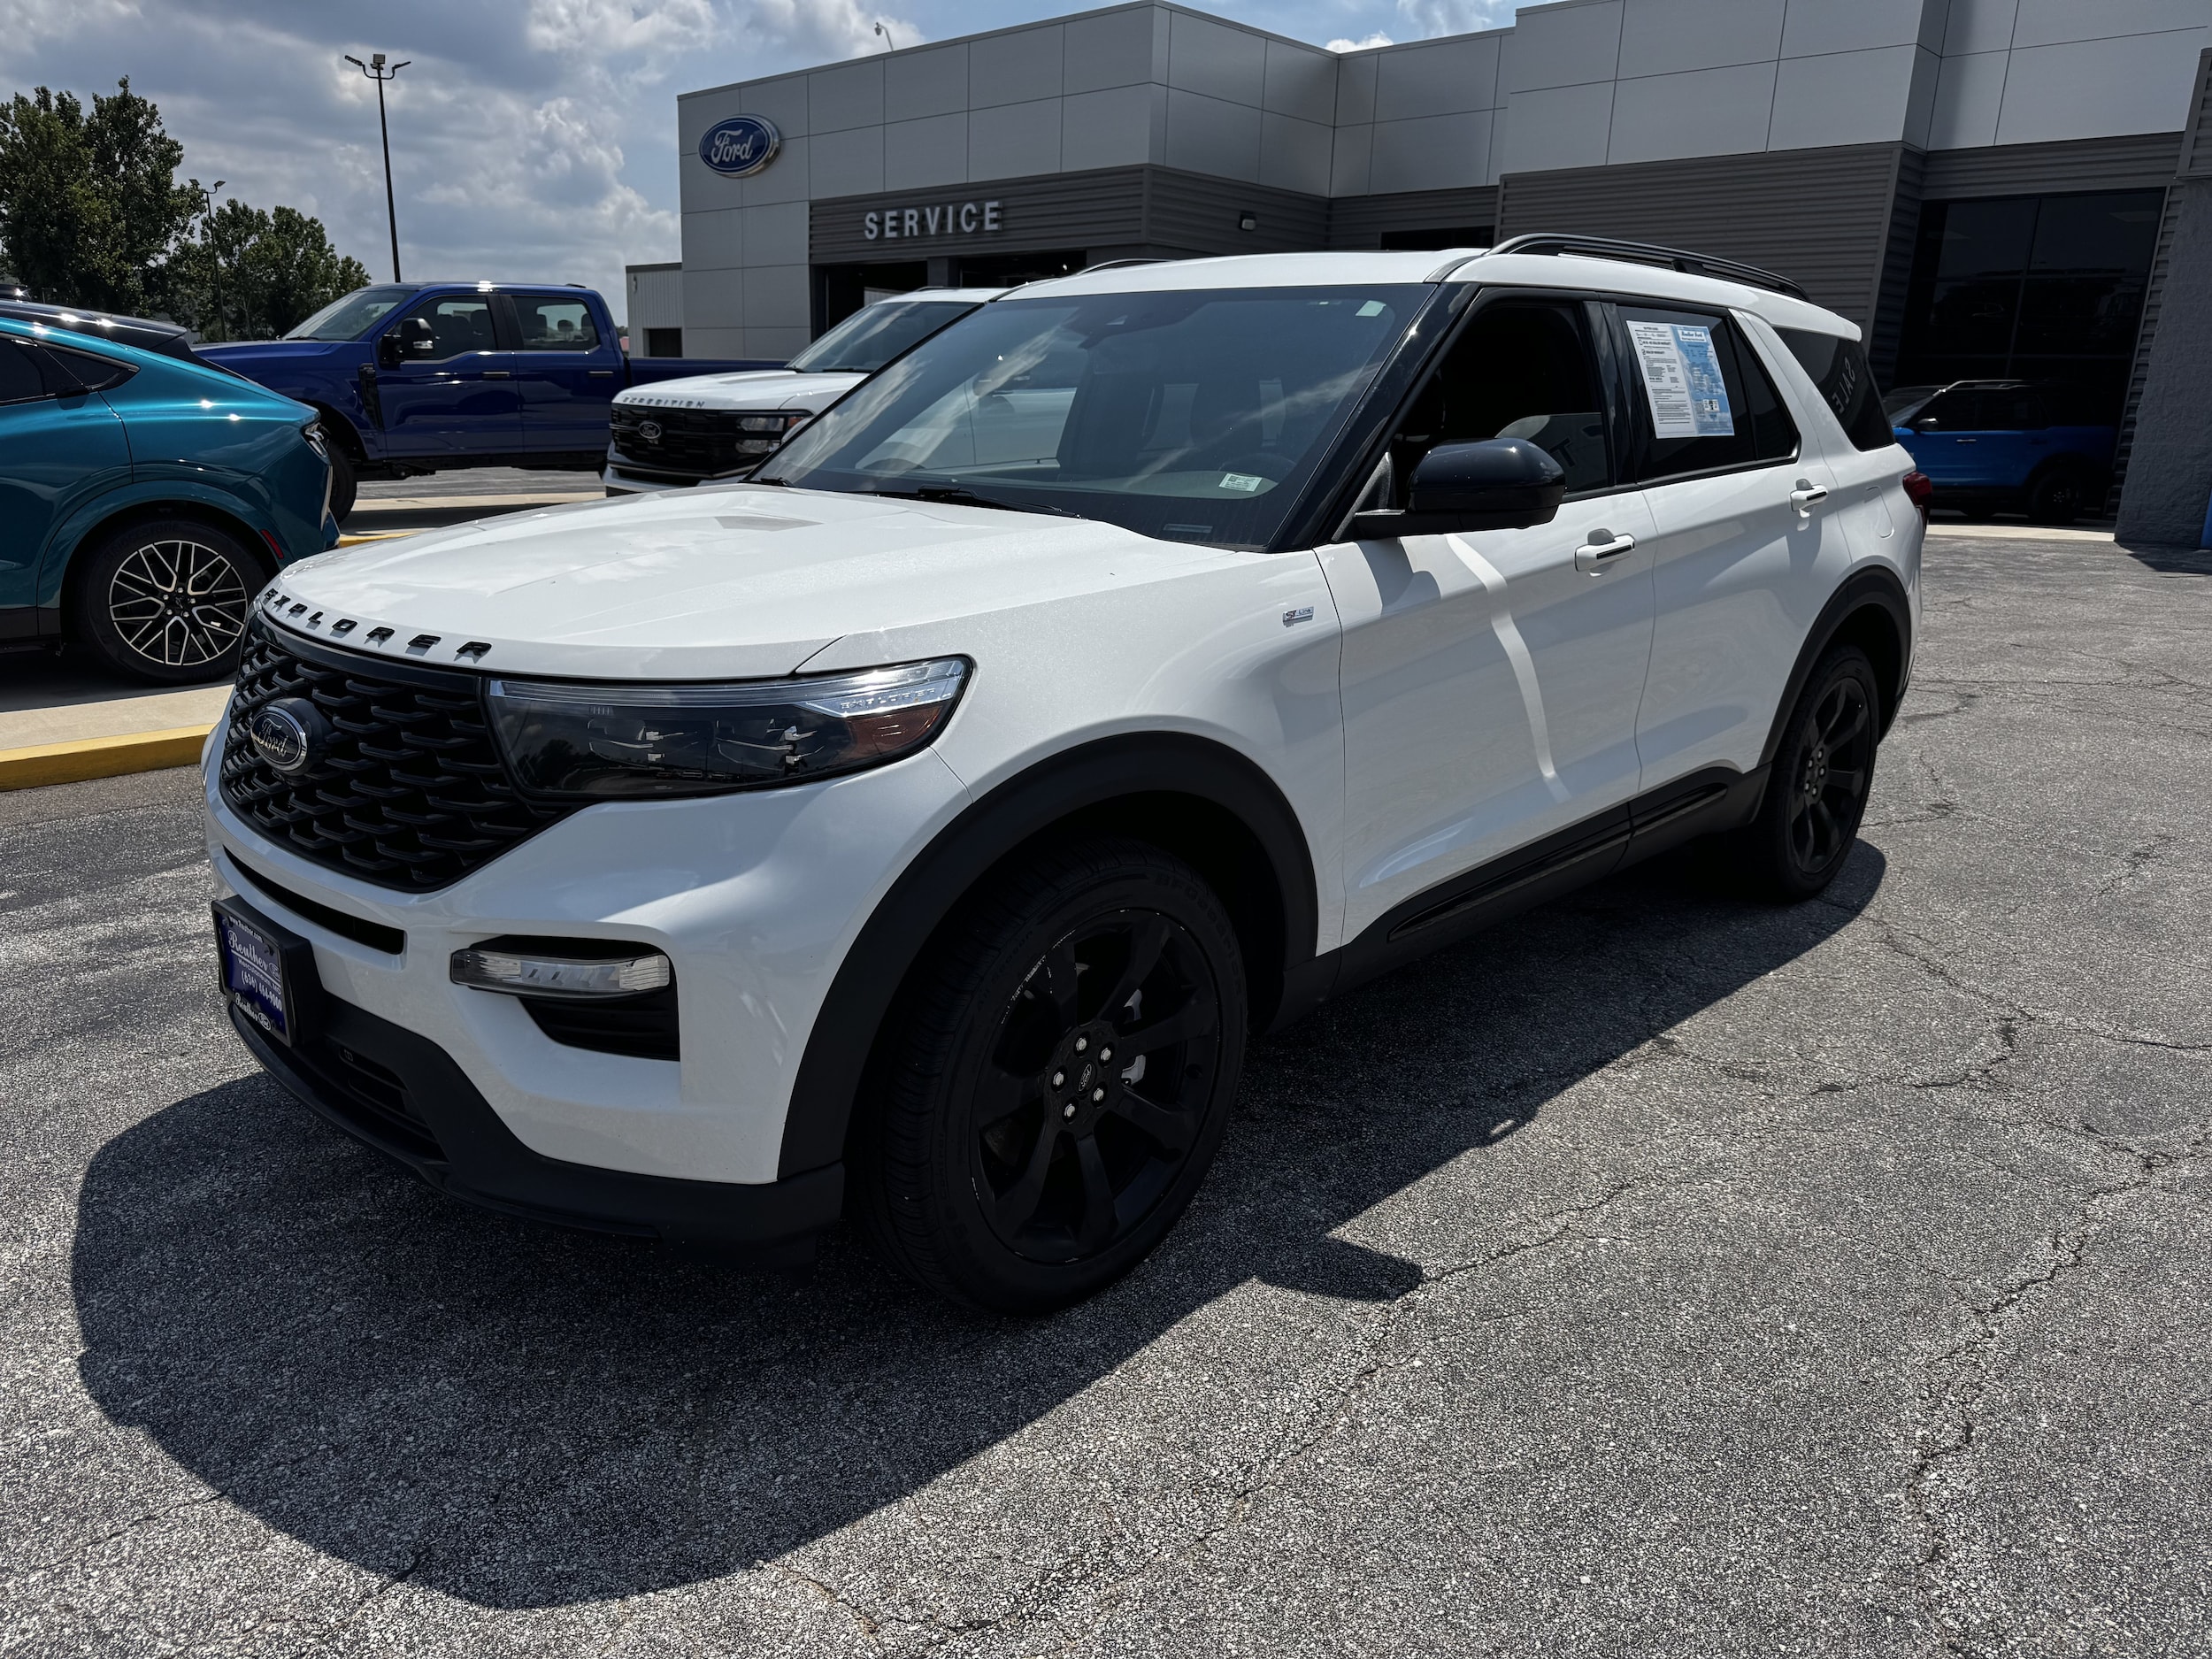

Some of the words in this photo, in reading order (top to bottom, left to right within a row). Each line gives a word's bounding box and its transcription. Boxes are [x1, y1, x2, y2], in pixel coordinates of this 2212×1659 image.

[710, 128, 754, 165] Ford
[864, 201, 1002, 241] SERVICE
[264, 588, 493, 657] EXPLORER
[257, 718, 290, 758] Ford
